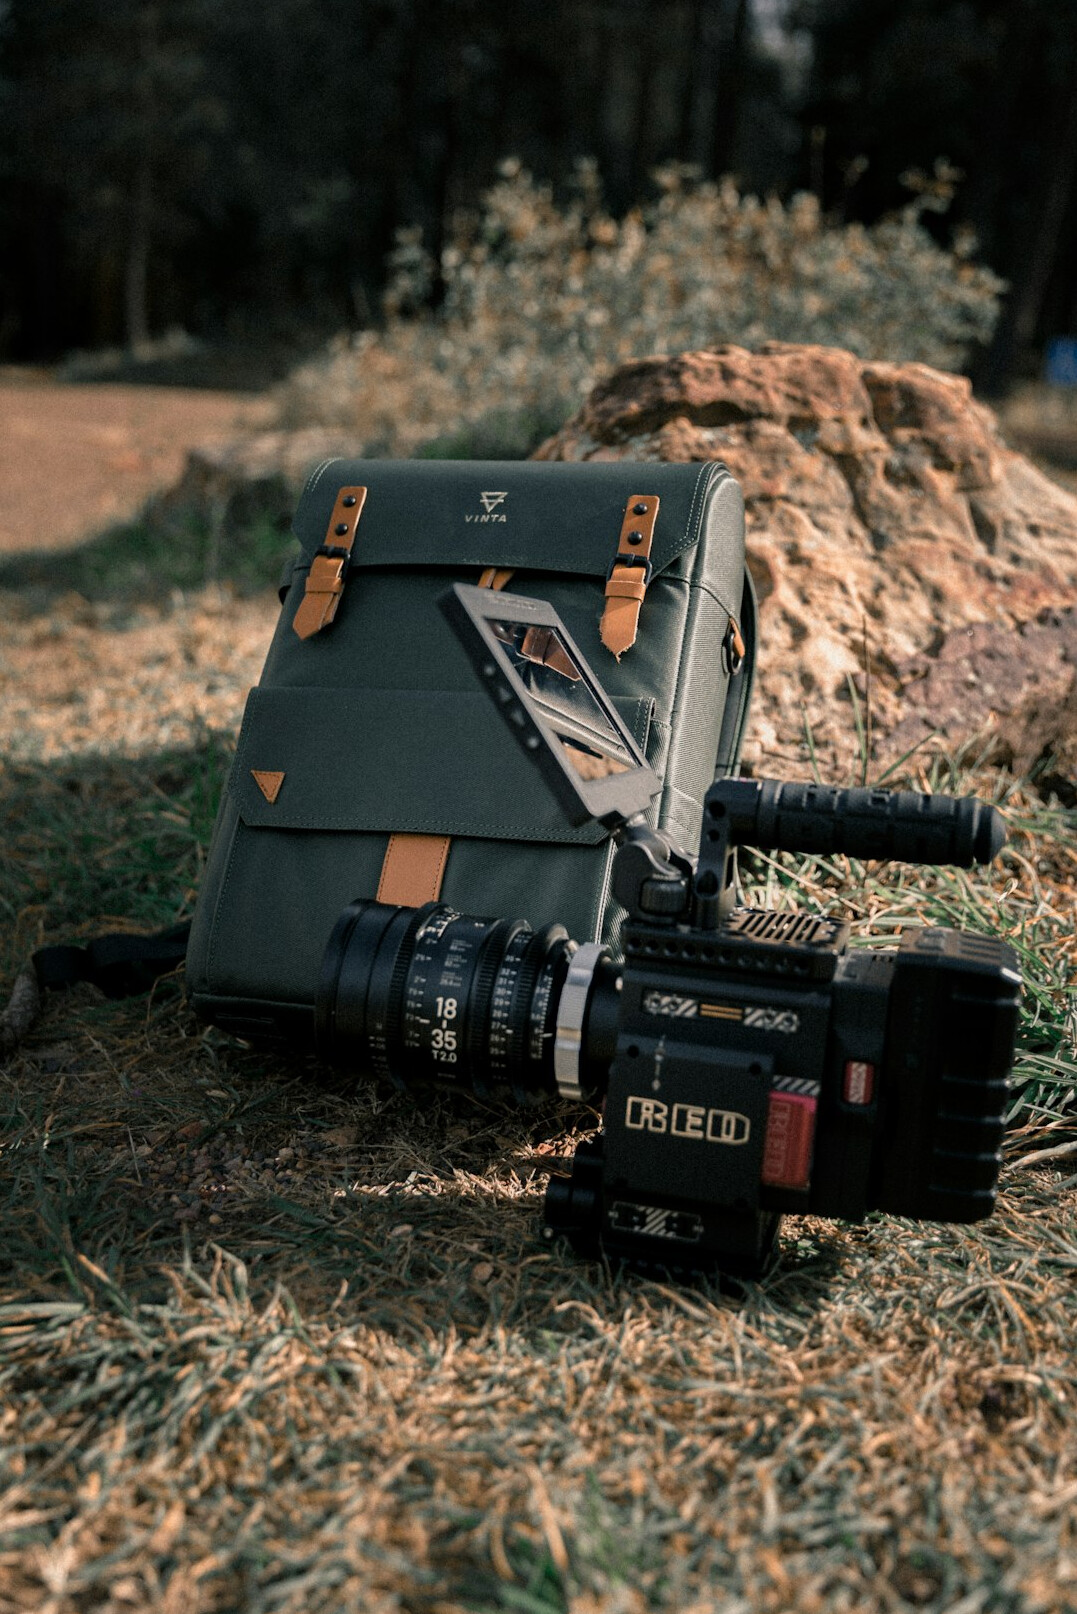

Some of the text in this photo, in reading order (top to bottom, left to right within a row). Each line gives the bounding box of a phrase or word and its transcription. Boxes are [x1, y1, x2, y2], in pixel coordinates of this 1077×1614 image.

[465, 514, 507, 523] VINTA
[435, 996, 458, 1020] 18
[431, 1028, 458, 1052] 35
[431, 1049, 458, 1064] T2.0
[625, 1095, 751, 1146] RED
